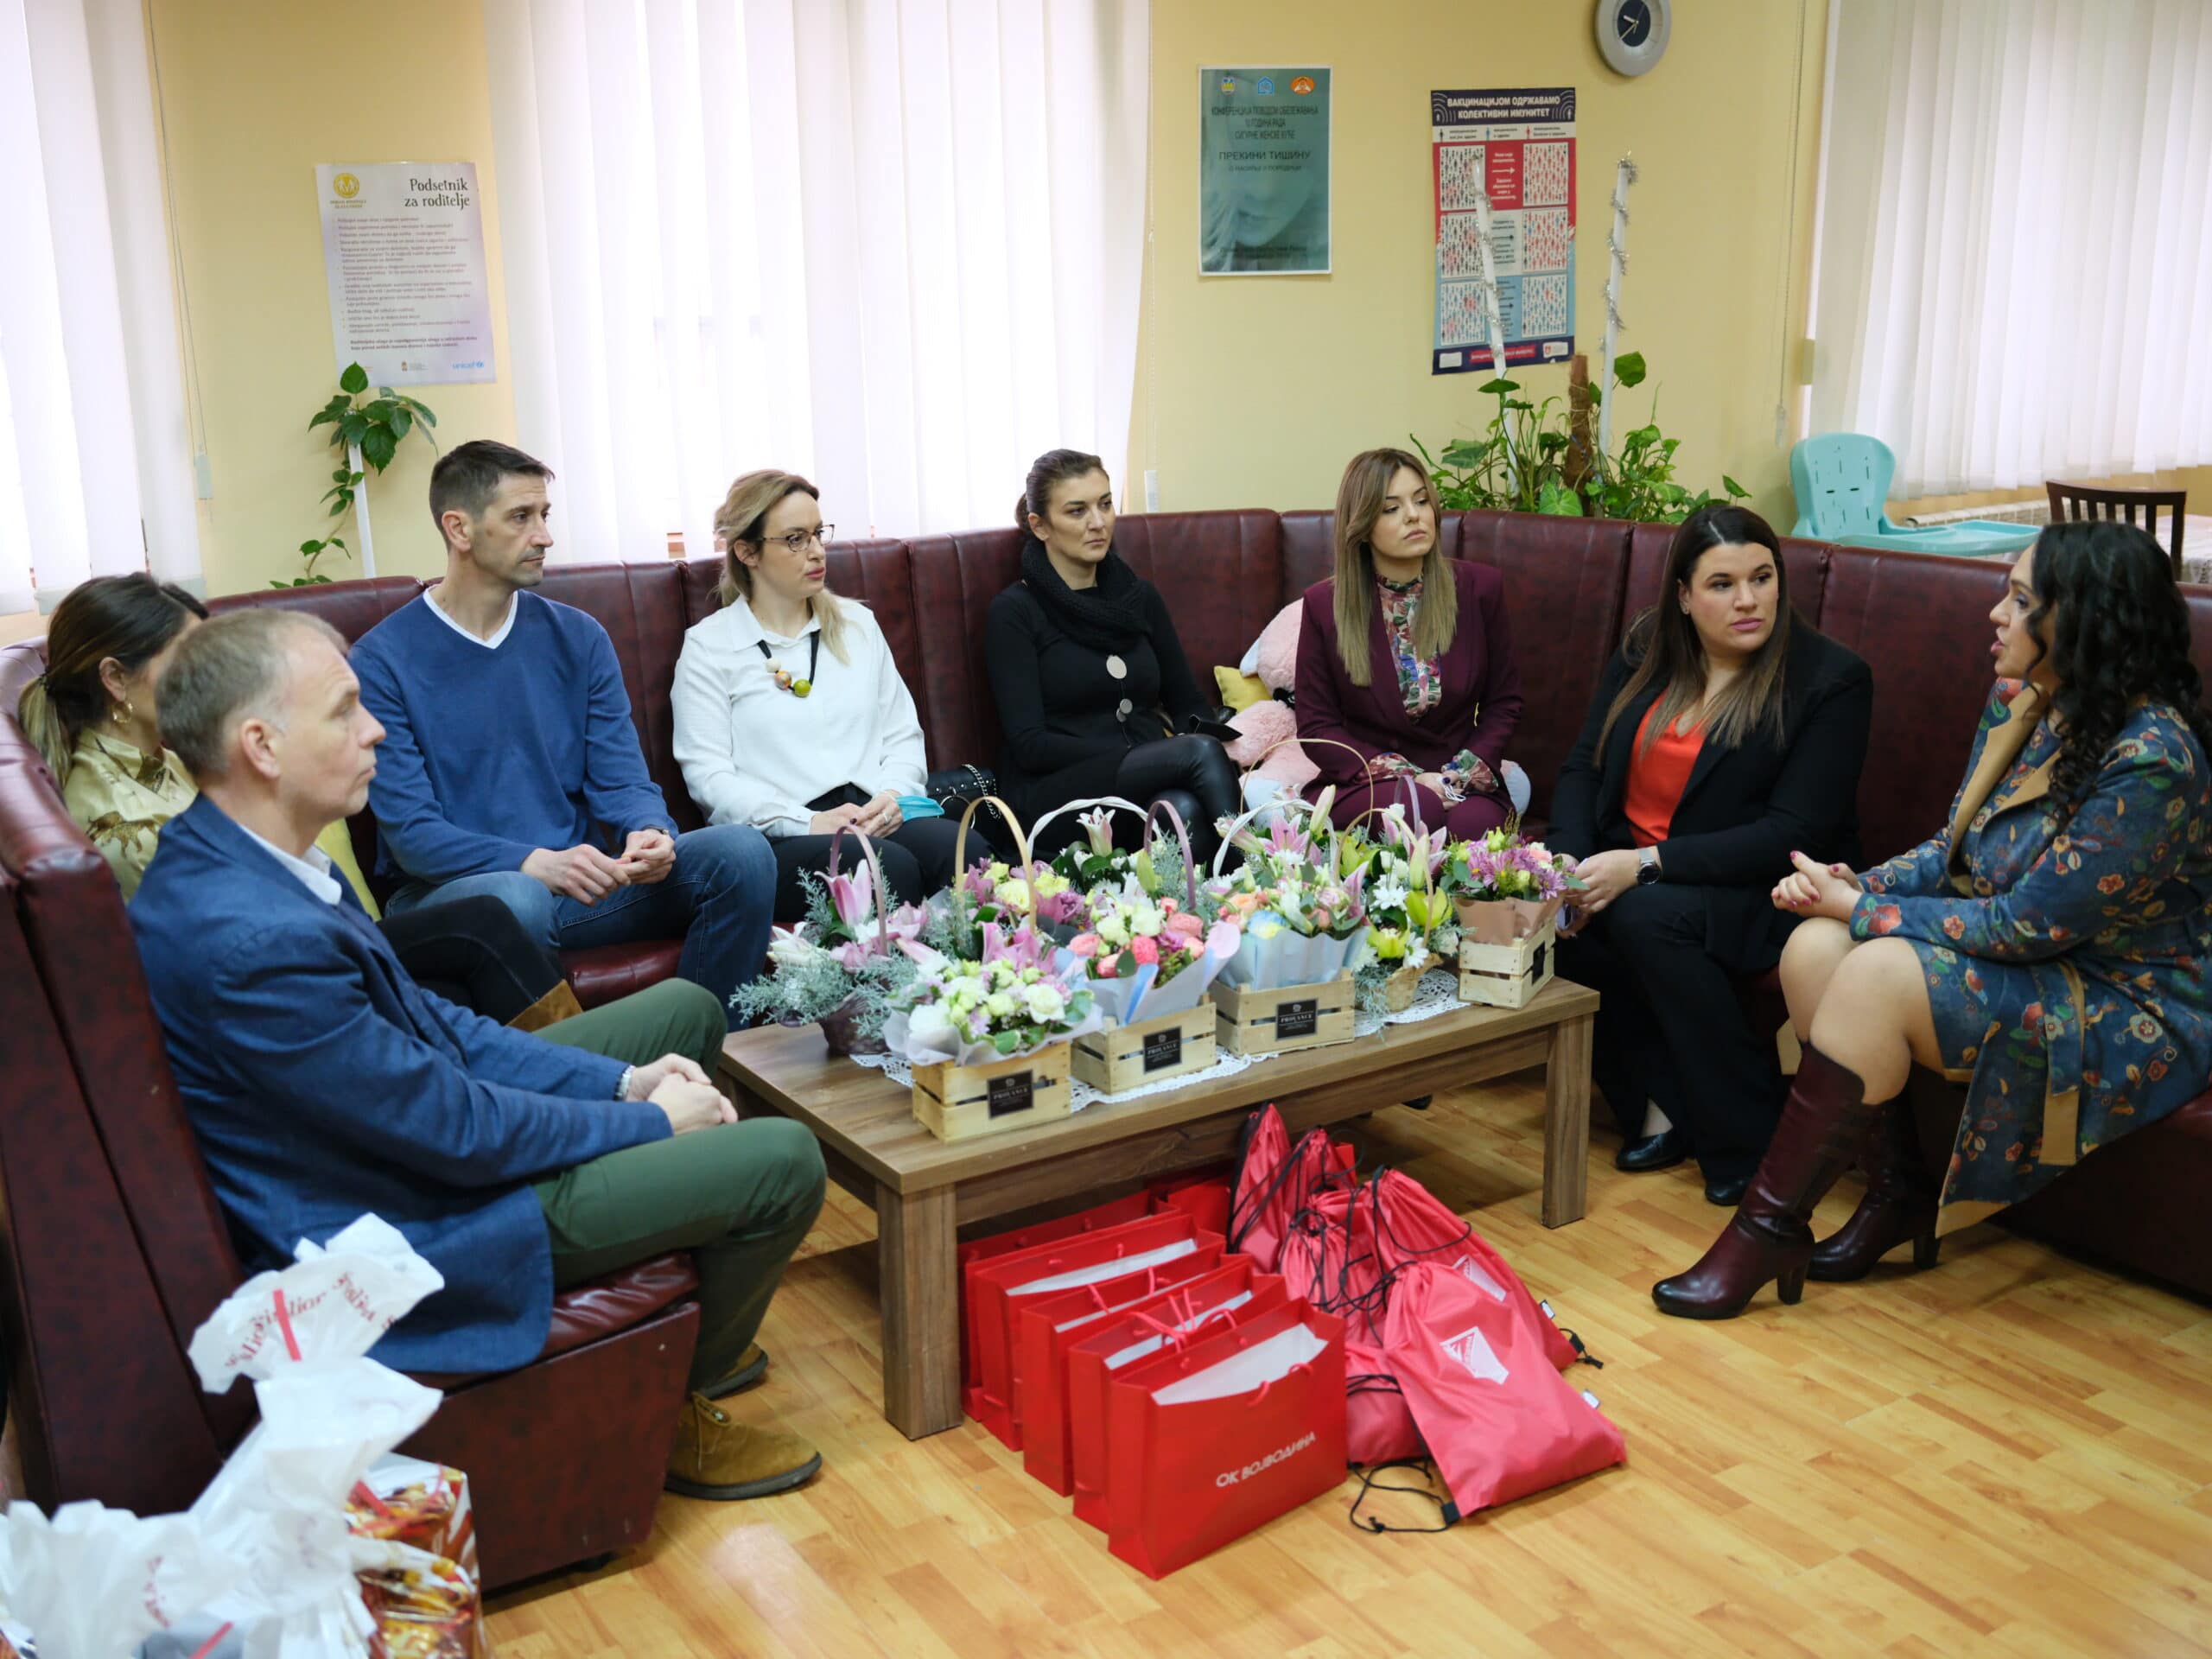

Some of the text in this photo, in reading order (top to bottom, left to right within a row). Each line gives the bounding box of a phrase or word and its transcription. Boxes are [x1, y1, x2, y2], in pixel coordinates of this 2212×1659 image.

[1447, 96, 1560, 108] ВАКЦИНАЦИЈОМ ОДРЖАВАМО
[1458, 108, 1550, 119] КОЛЕКТИВНИ ИМУНИТЕТ
[1218, 150, 1311, 160] ПРЕКИНИ ТИШИНУ
[410, 177, 469, 192] Podsetnik
[404, 193, 470, 210] za roditelje
[1216, 1430, 1316, 1487] ОК ВОЈВОДИНА
